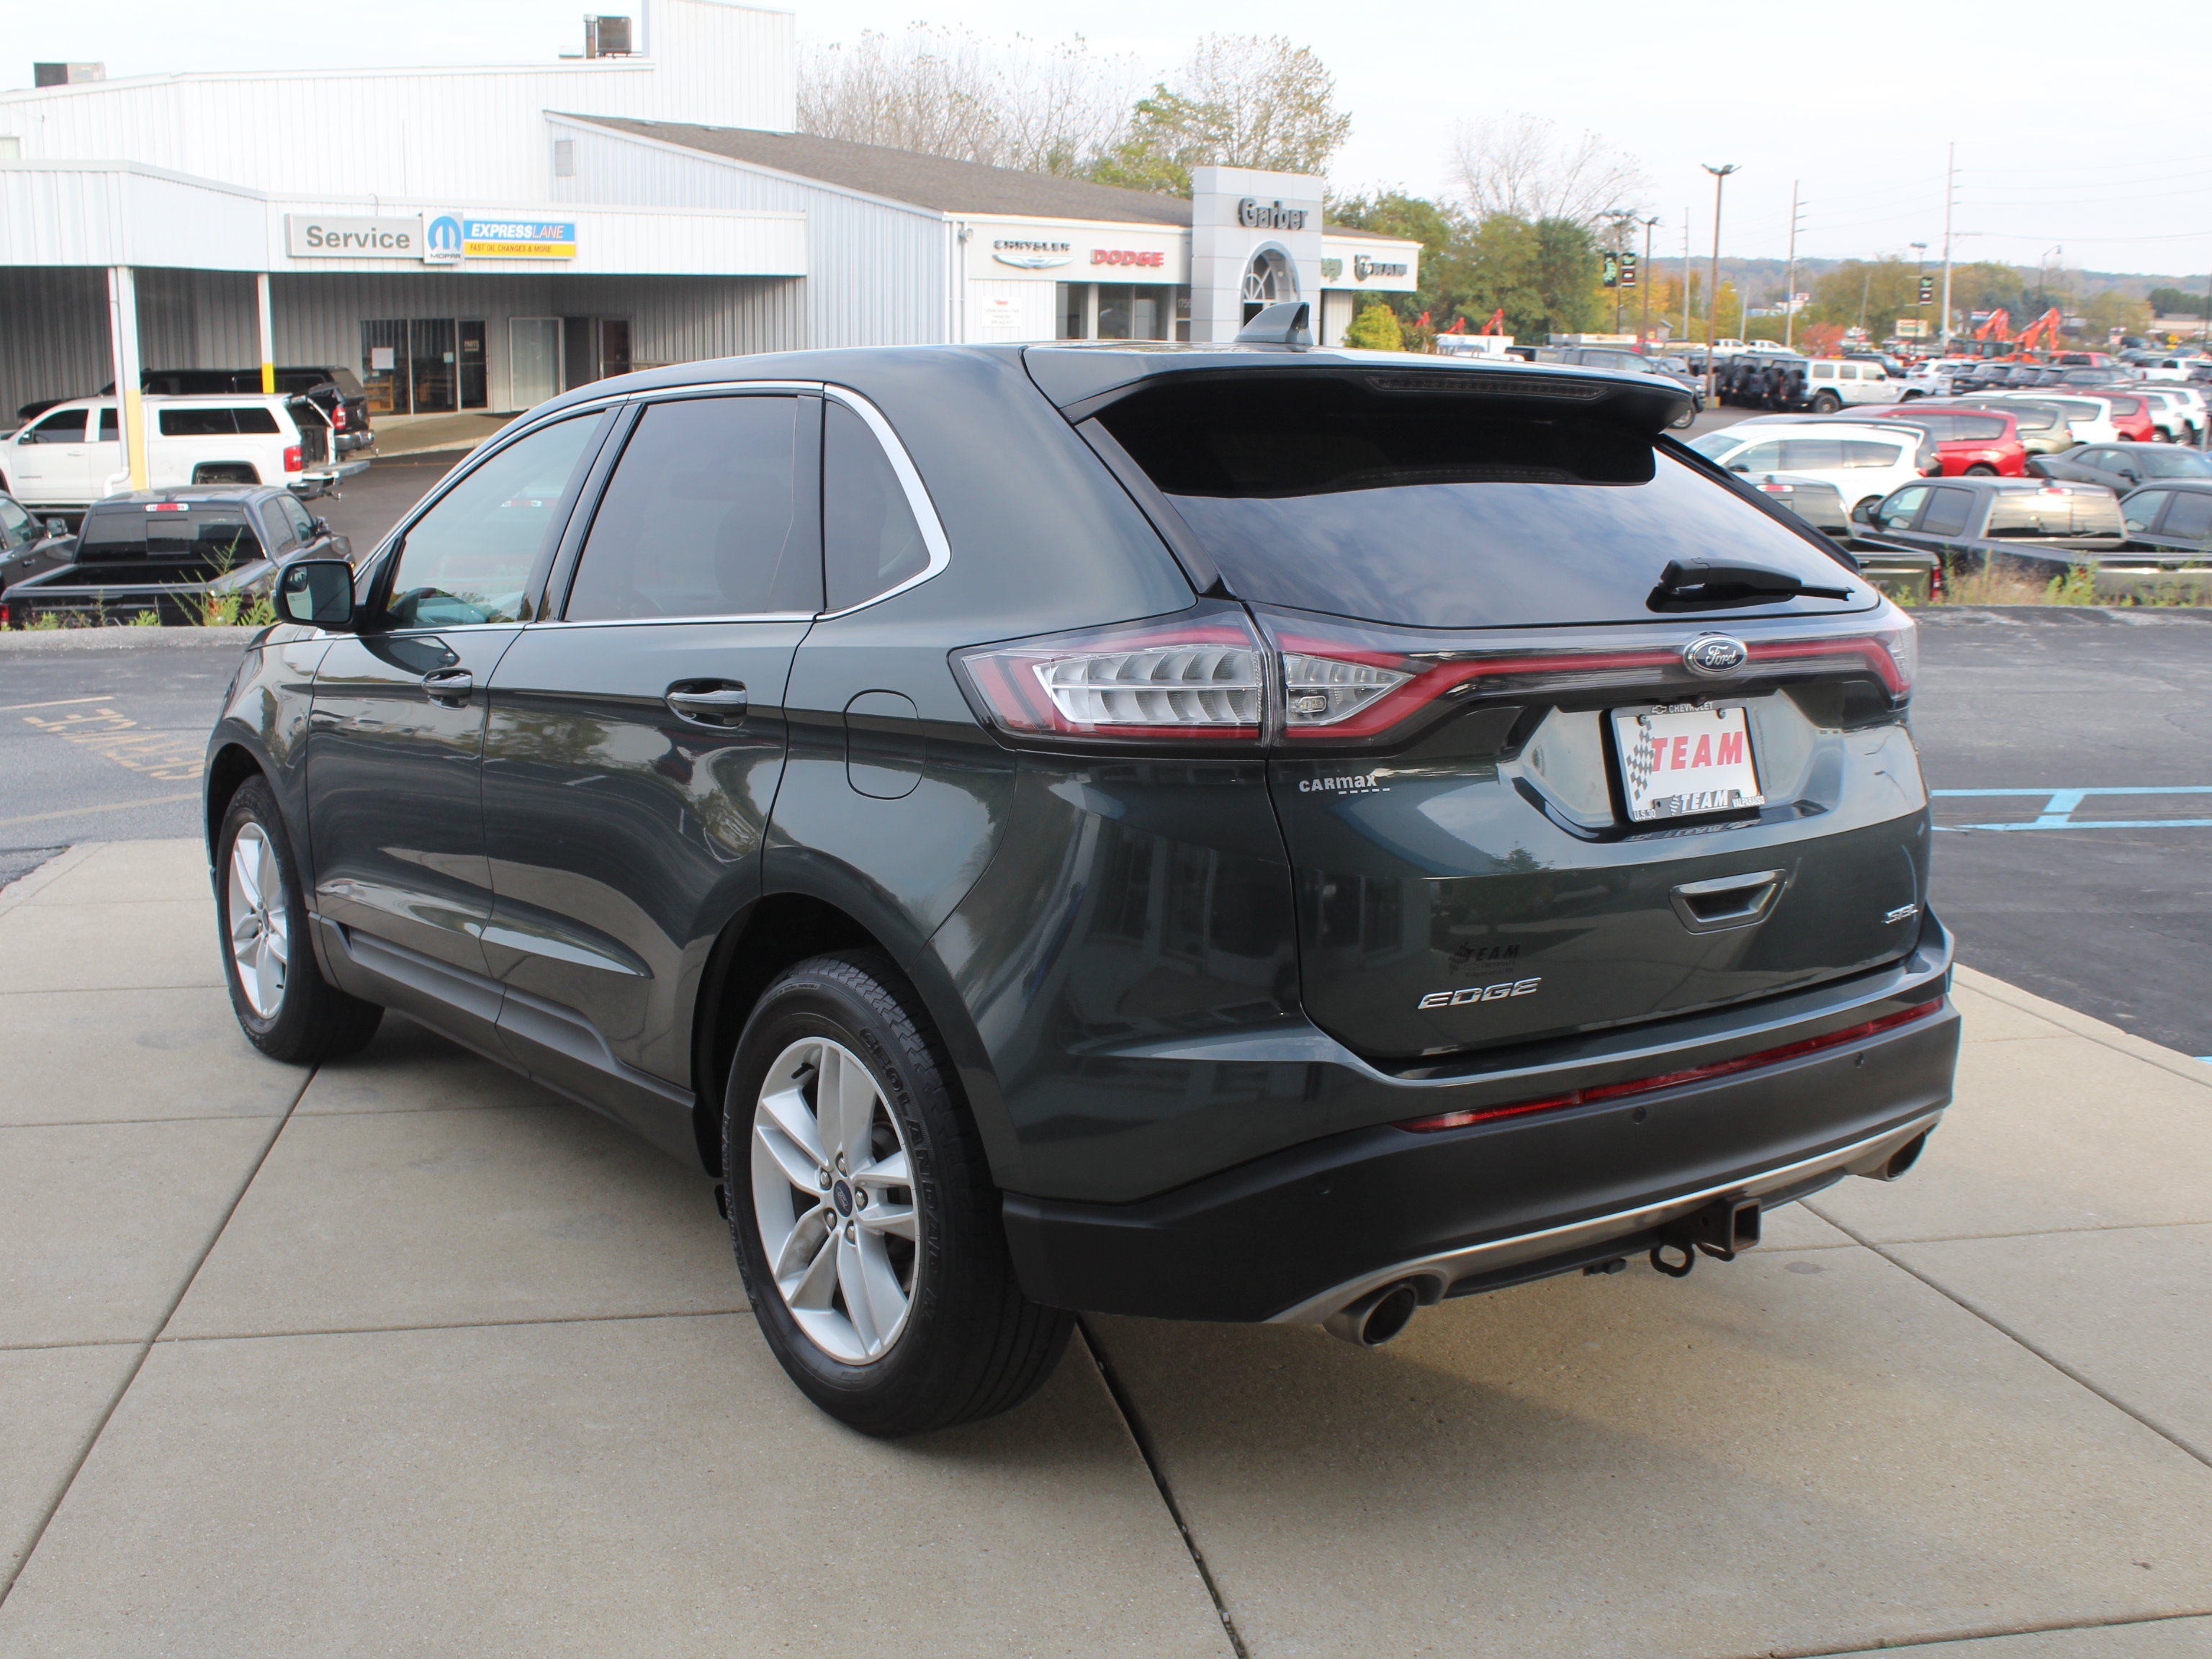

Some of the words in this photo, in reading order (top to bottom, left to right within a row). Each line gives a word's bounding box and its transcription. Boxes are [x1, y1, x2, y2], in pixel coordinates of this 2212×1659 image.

[1238, 197, 1308, 230] Garber
[306, 225, 410, 249] Service
[994, 240, 1071, 251] CHRYSLER
[1090, 249, 1164, 267] DODGE
[1370, 263, 1408, 276] RAM
[1705, 645, 1737, 666] Ford
[1652, 731, 1743, 772] TEAM
[1681, 790, 1729, 812] TEAM
[1882, 903, 1919, 924] SEL
[1465, 944, 1521, 962] TEAM
[1418, 976, 1542, 1010] EDGE
